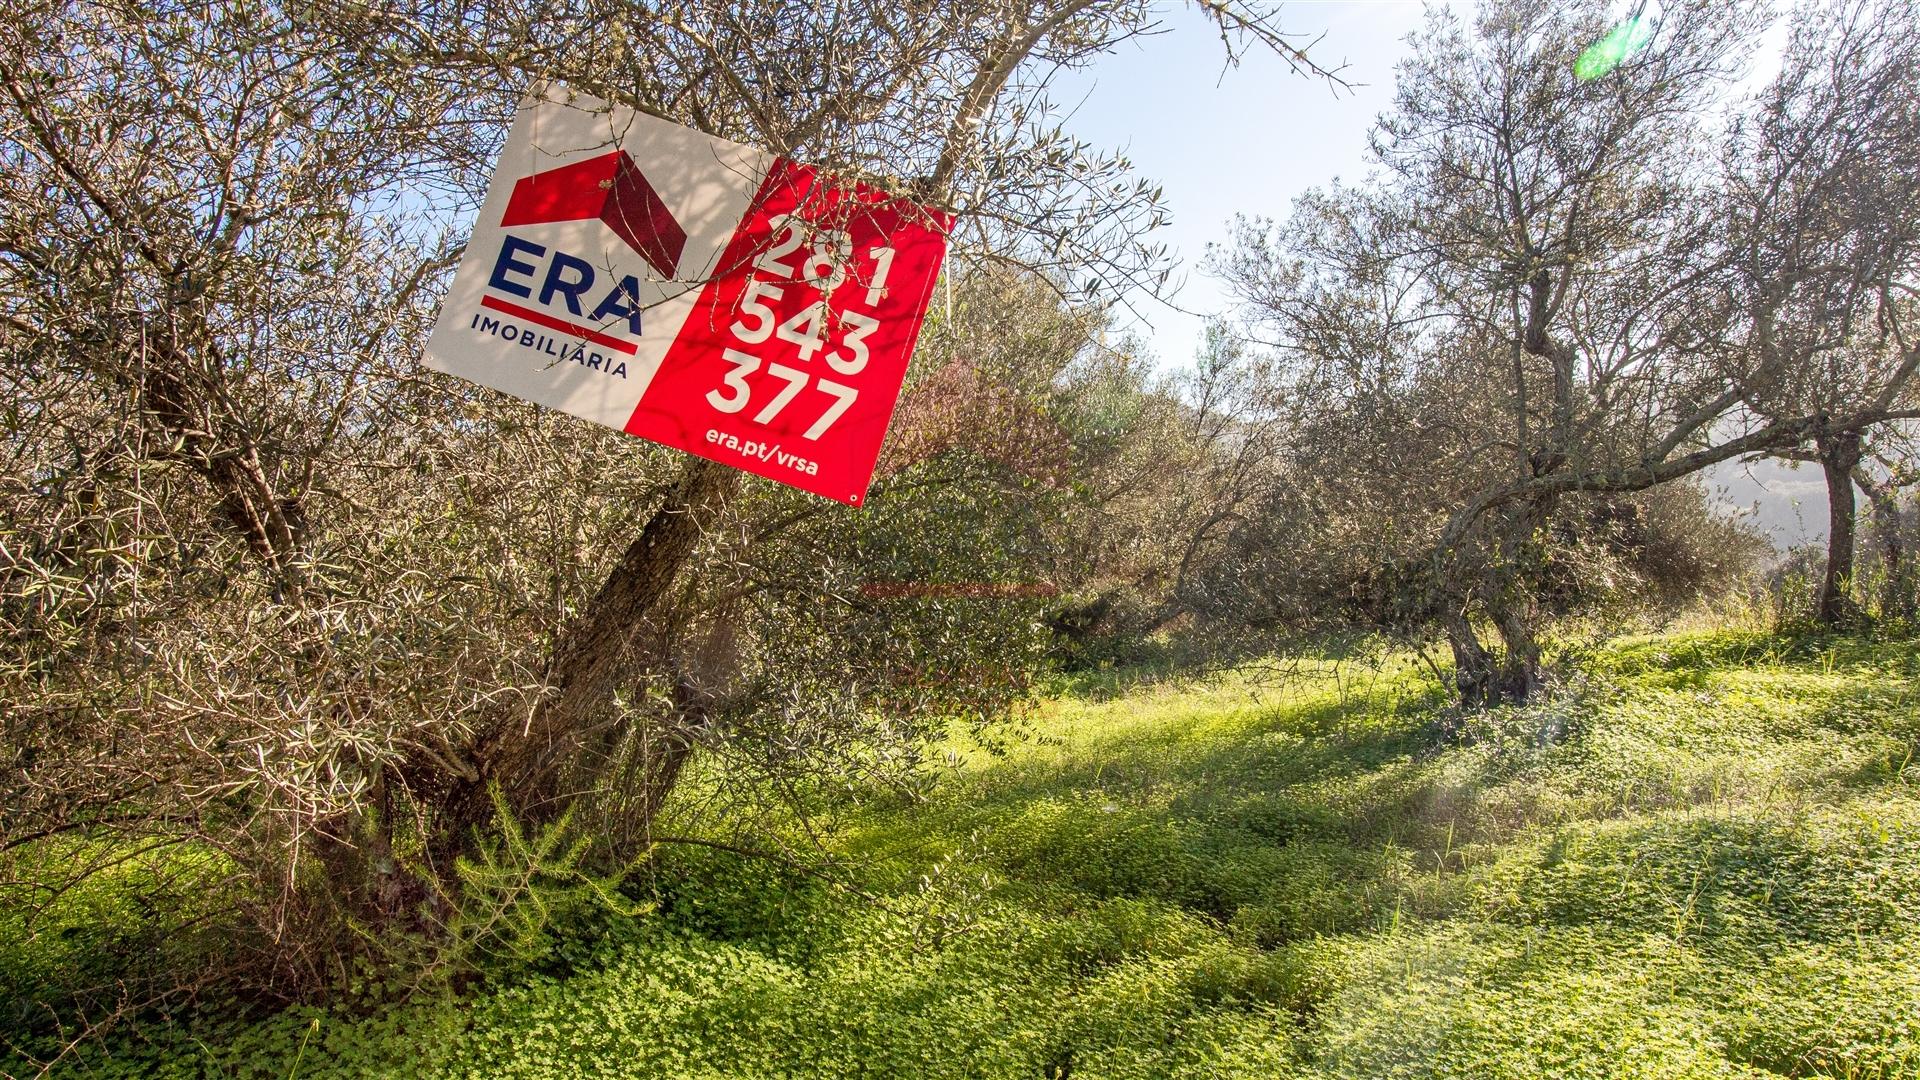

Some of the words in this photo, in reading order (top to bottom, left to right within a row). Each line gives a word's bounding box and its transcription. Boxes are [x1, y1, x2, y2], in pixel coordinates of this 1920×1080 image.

[488, 234, 642, 337] ERA
[752, 213, 896, 308] 281
[470, 313, 628, 379] IMOBILIÁRIA
[729, 280, 881, 376] 543
[705, 347, 859, 442] 377
[705, 428, 819, 477] era.pt/vrsa
